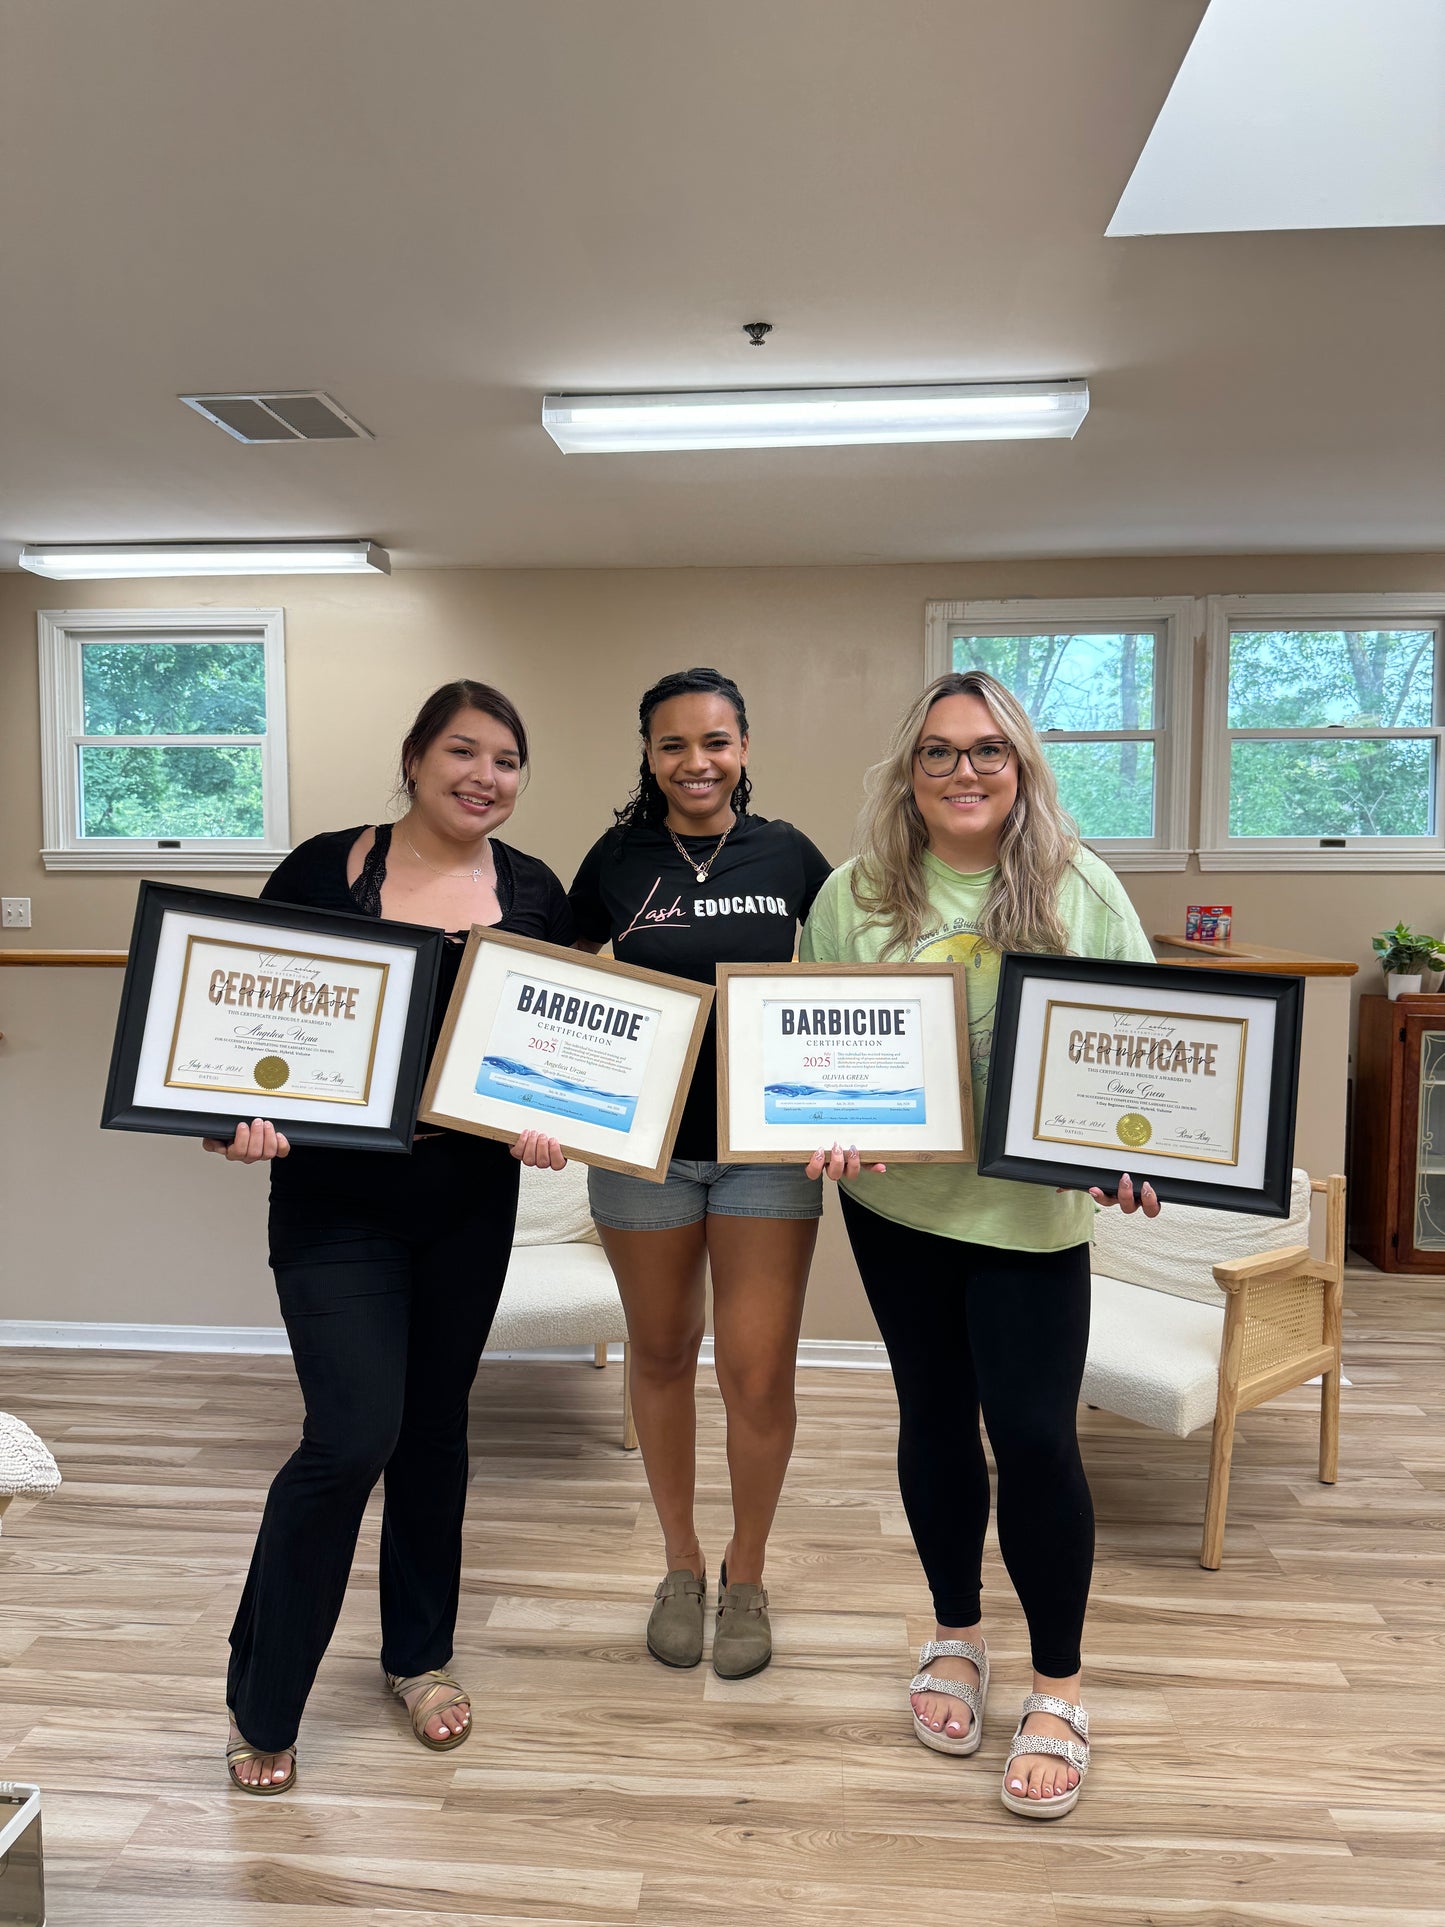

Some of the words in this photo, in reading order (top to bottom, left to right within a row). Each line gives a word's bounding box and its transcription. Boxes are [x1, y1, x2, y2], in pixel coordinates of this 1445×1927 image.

[618, 876, 690, 942] Lash
[694, 896, 788, 917] EDUCATOR
[209, 970, 359, 1020] CERTIFICATE
[210, 980, 231, 1005] of
[239, 983, 355, 1010] completion
[240, 1010, 271, 1019] CERTIFICATE
[537, 1022, 613, 1046] CERTIFICATION
[528, 1037, 556, 1054] 2025
[1068, 1030, 1218, 1077] CERTIFICATE
[1069, 1039, 1087, 1064] of
[1097, 1040, 1215, 1070] completion
[544, 1059, 568, 1071] Angelica
[803, 1056, 831, 1067] 2025
[1099, 1068, 1129, 1076] CERTIFICATE
[1107, 1078, 1135, 1095] Olivia
[1136, 1081, 1166, 1099] Green
